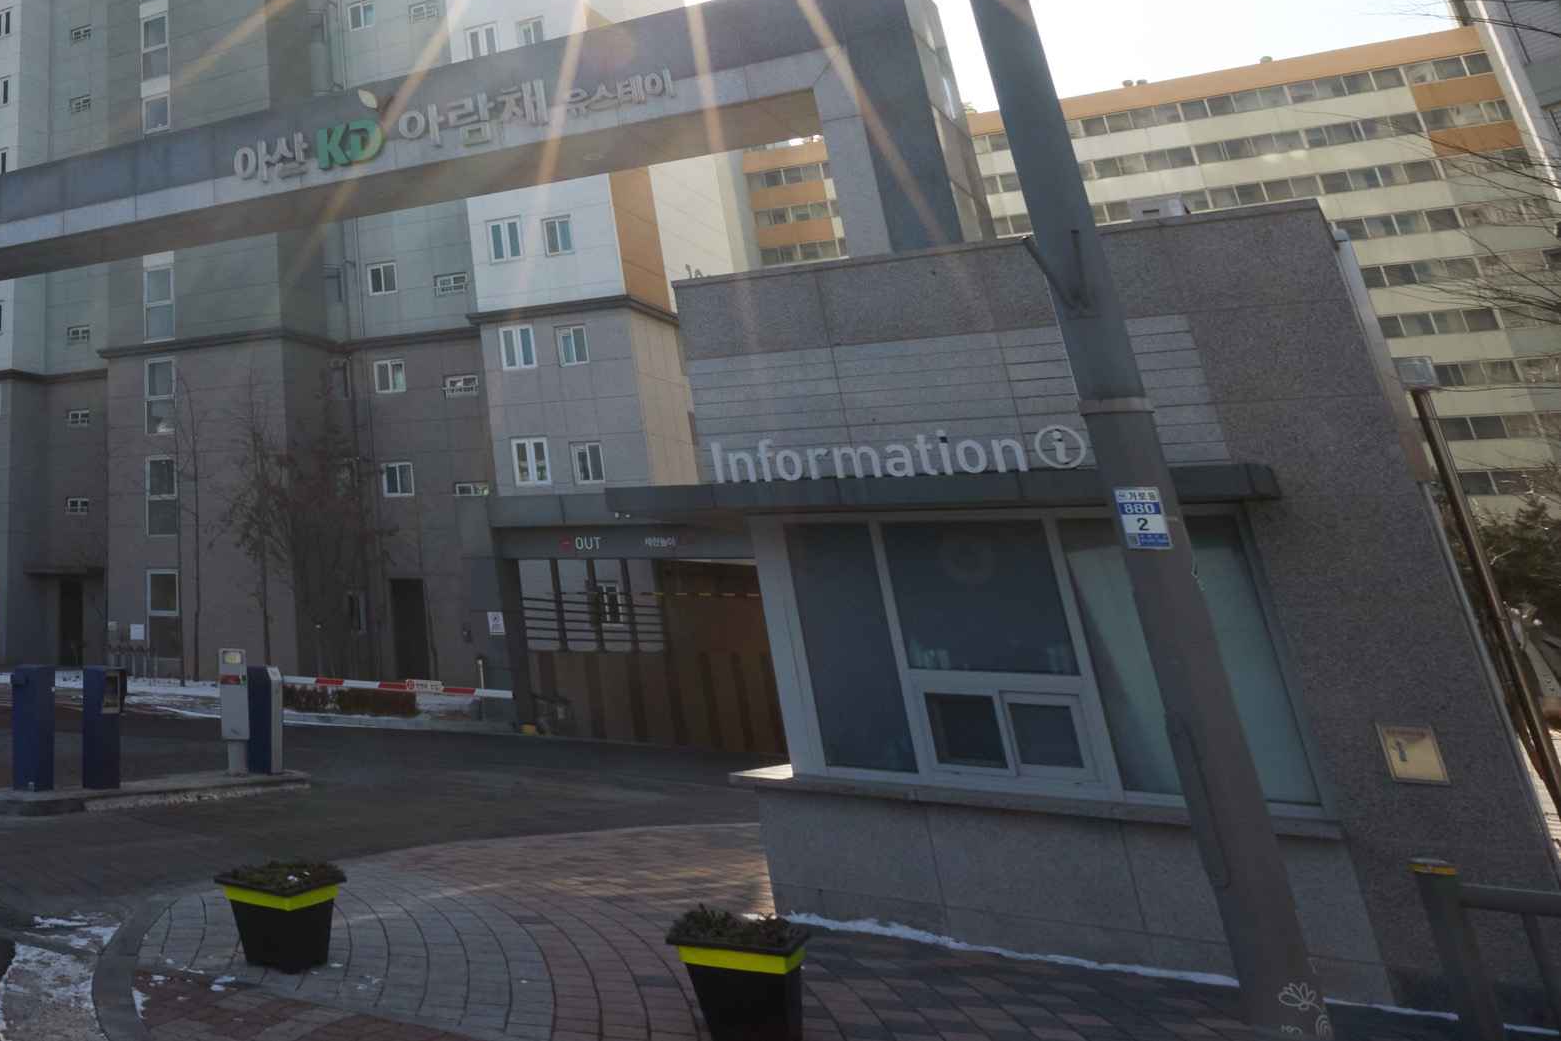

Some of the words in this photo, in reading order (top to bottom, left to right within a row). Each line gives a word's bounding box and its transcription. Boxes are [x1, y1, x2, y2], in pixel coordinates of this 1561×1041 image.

[234, 131, 308, 182] 아산
[317, 119, 384, 170] KD
[398, 79, 549, 147] 아람채
[711, 429, 1029, 484] Information
[1123, 503, 1155, 514] 880
[1137, 517, 1150, 531] 2
[575, 536, 601, 550] OUT
